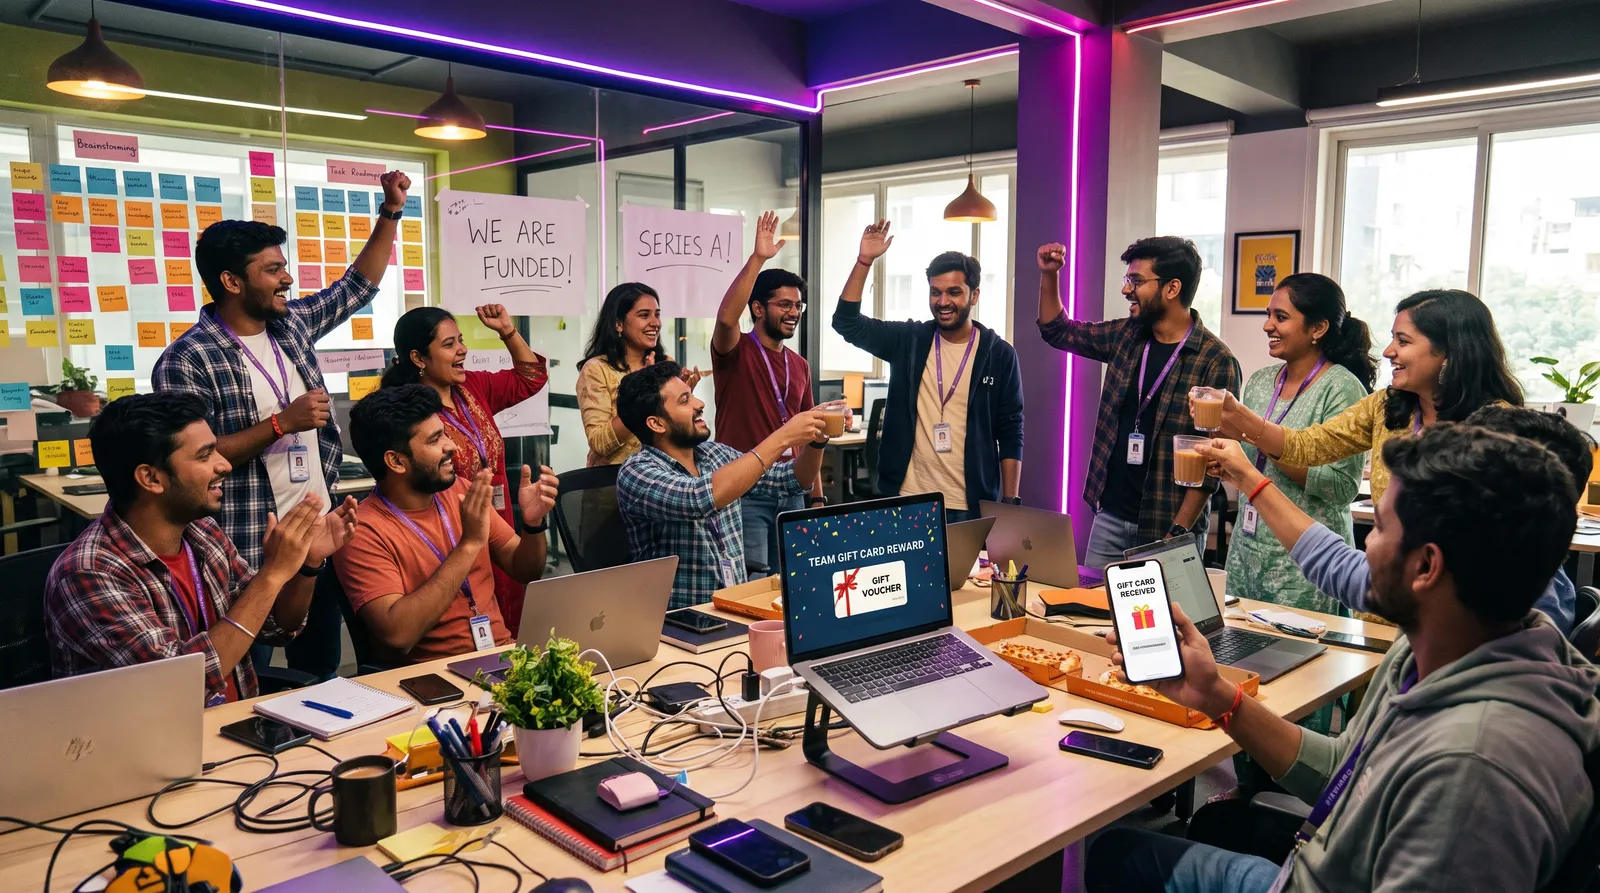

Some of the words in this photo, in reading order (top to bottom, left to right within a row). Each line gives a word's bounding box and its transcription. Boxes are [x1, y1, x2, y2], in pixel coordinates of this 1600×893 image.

[77, 138, 136, 157] Brainstorming
[329, 165, 346, 176] Task
[467, 218, 502, 244] WE
[516, 220, 555, 246] ARE
[637, 229, 703, 258] SERIES
[710, 231, 731, 264] A!
[483, 254, 572, 284] FUNDED!
[808, 554, 836, 568] TEAM
[837, 550, 858, 563] GIFT
[860, 546, 885, 559] CARD
[887, 539, 925, 554] REWARD
[872, 574, 890, 585] GIFT
[1116, 580, 1133, 590] GIFT
[1134, 577, 1156, 587] CARD
[862, 583, 902, 598] VOUCHER
[1120, 586, 1156, 598] RECEIVED
